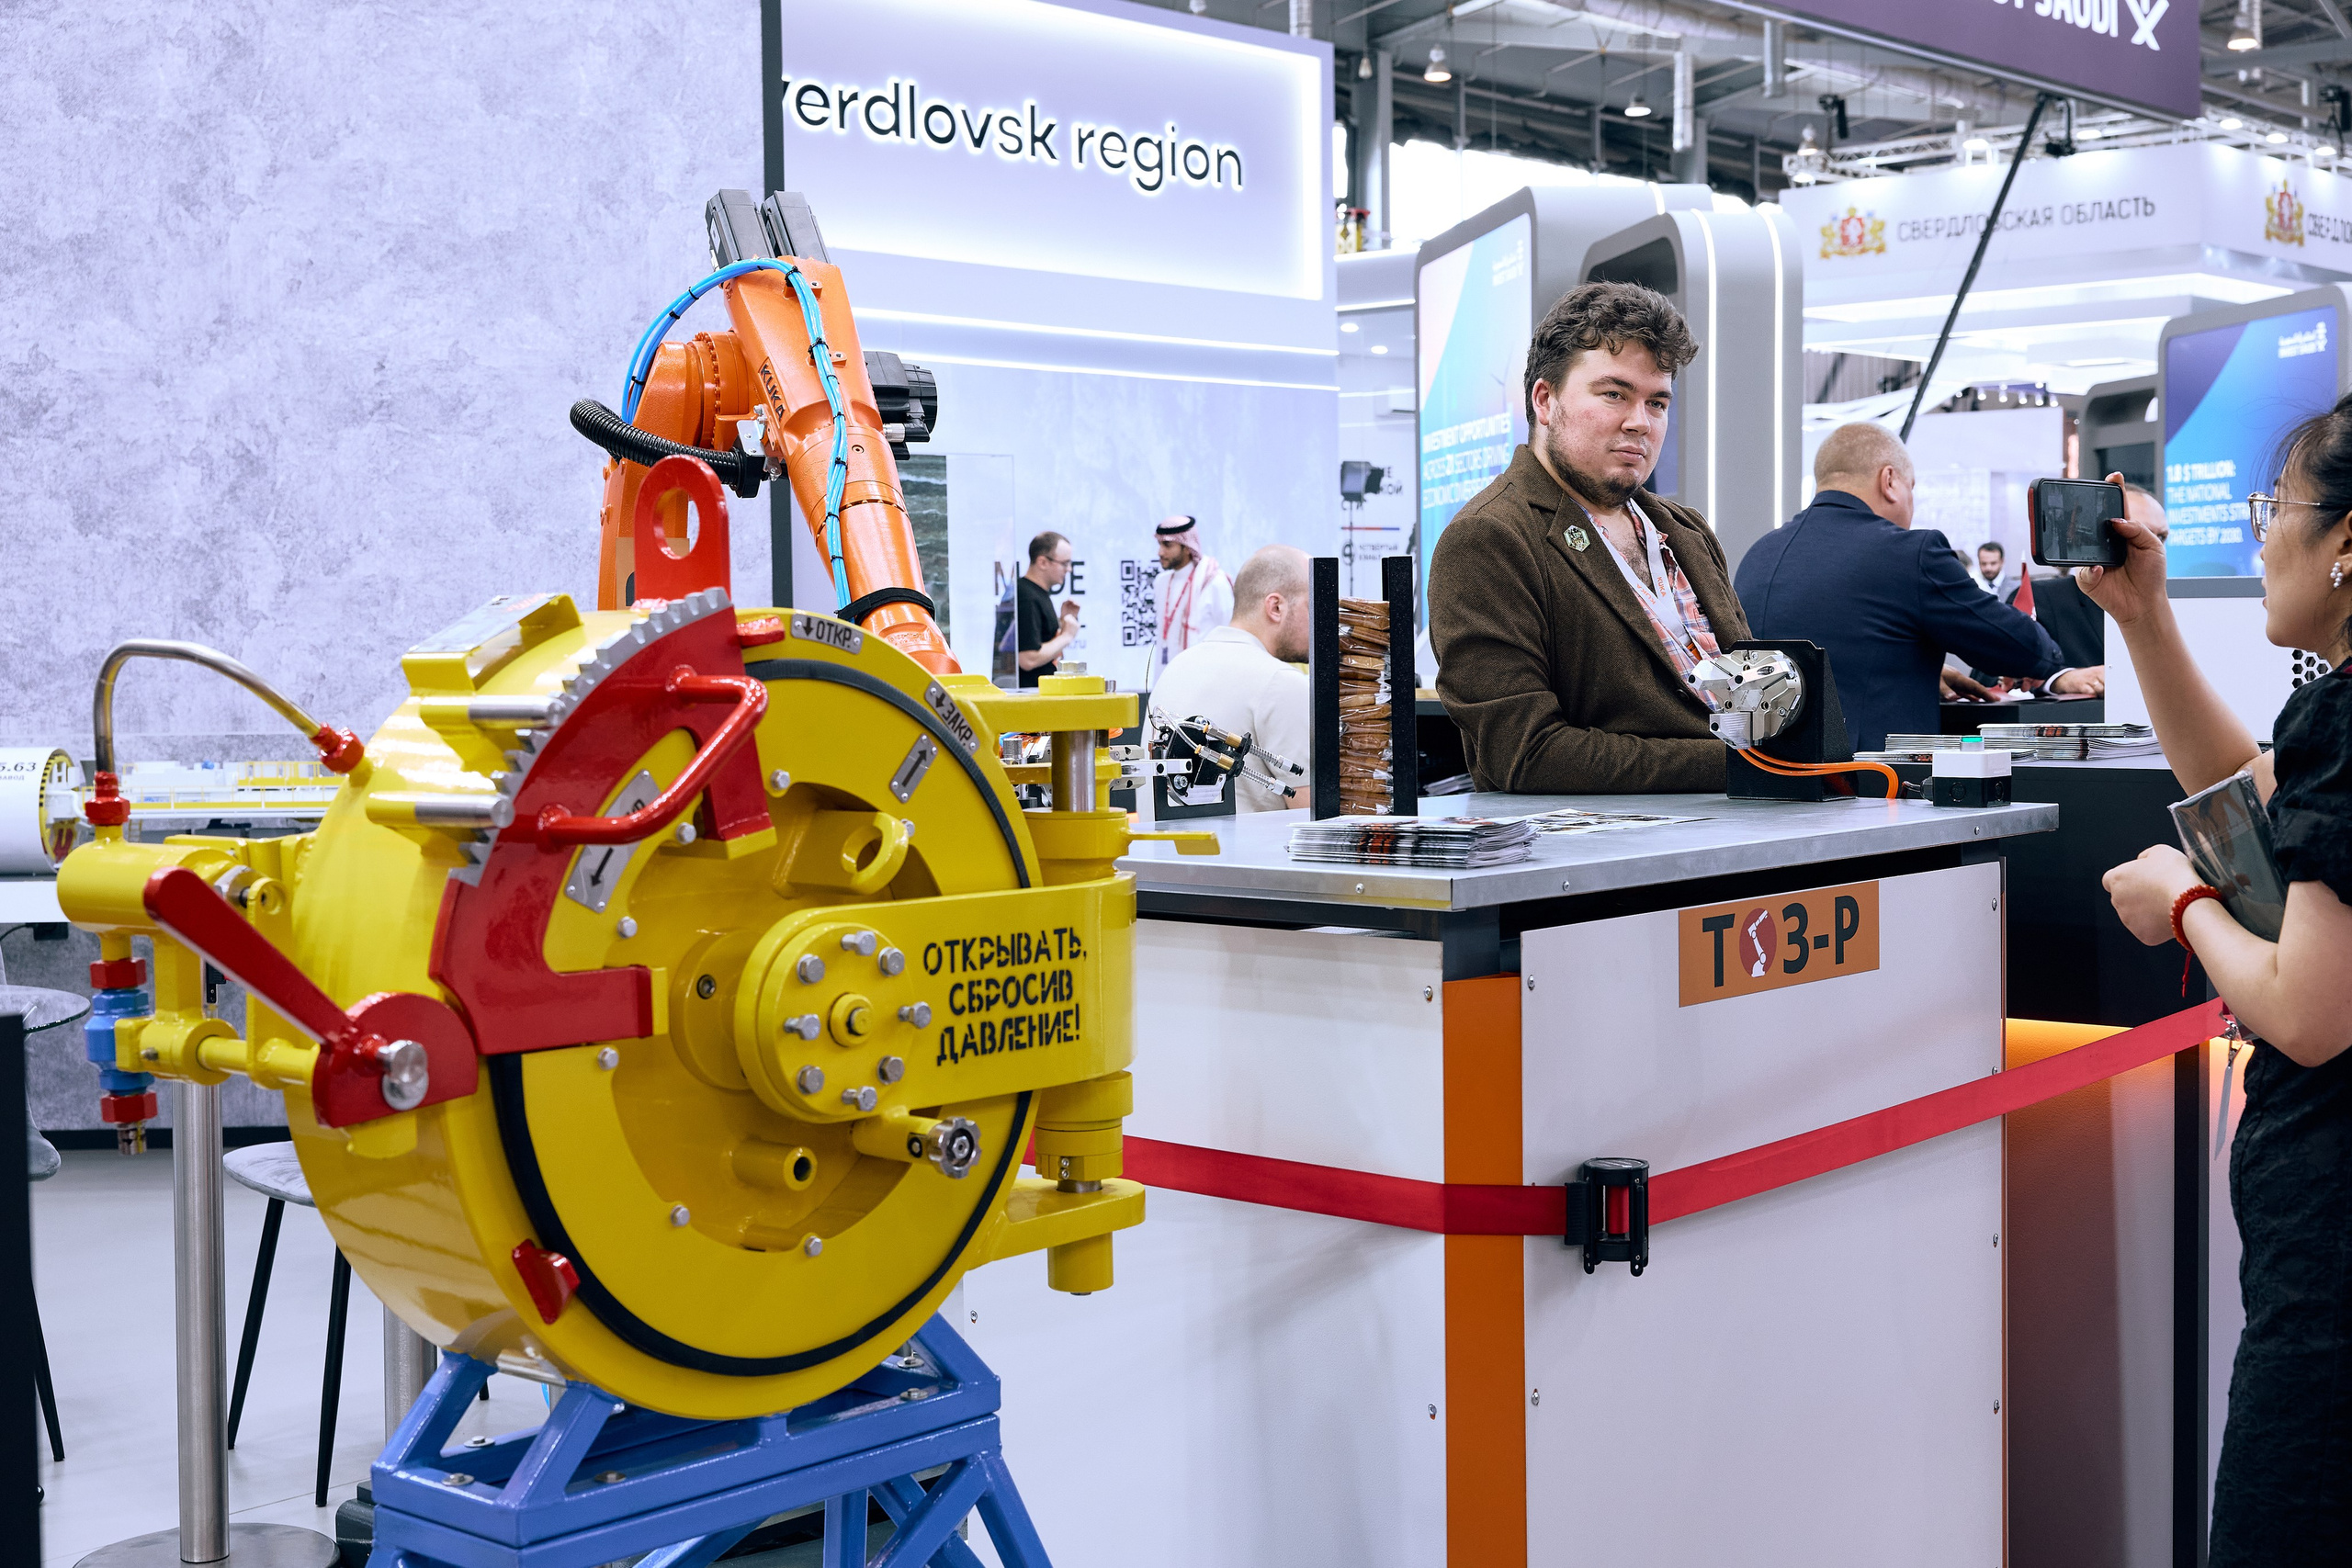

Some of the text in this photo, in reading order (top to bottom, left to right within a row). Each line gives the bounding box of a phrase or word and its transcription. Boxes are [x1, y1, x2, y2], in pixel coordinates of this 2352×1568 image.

[1078, 123, 1243, 192] region
[1897, 197, 2156, 242] СВЕРДЛОСКАЯ ОБЛАСТЬ
[761, 364, 786, 422] KUKA
[1657, 576, 1668, 598] KUKA
[816, 620, 851, 649] ОТКР.
[942, 702, 974, 746] ЗАКР.
[923, 927, 1087, 976] ОТКРЫВАТЬ,
[949, 969, 1073, 1016] СБРОСИВ
[937, 1003, 1080, 1066] ДАВЛЕНИЕ!
